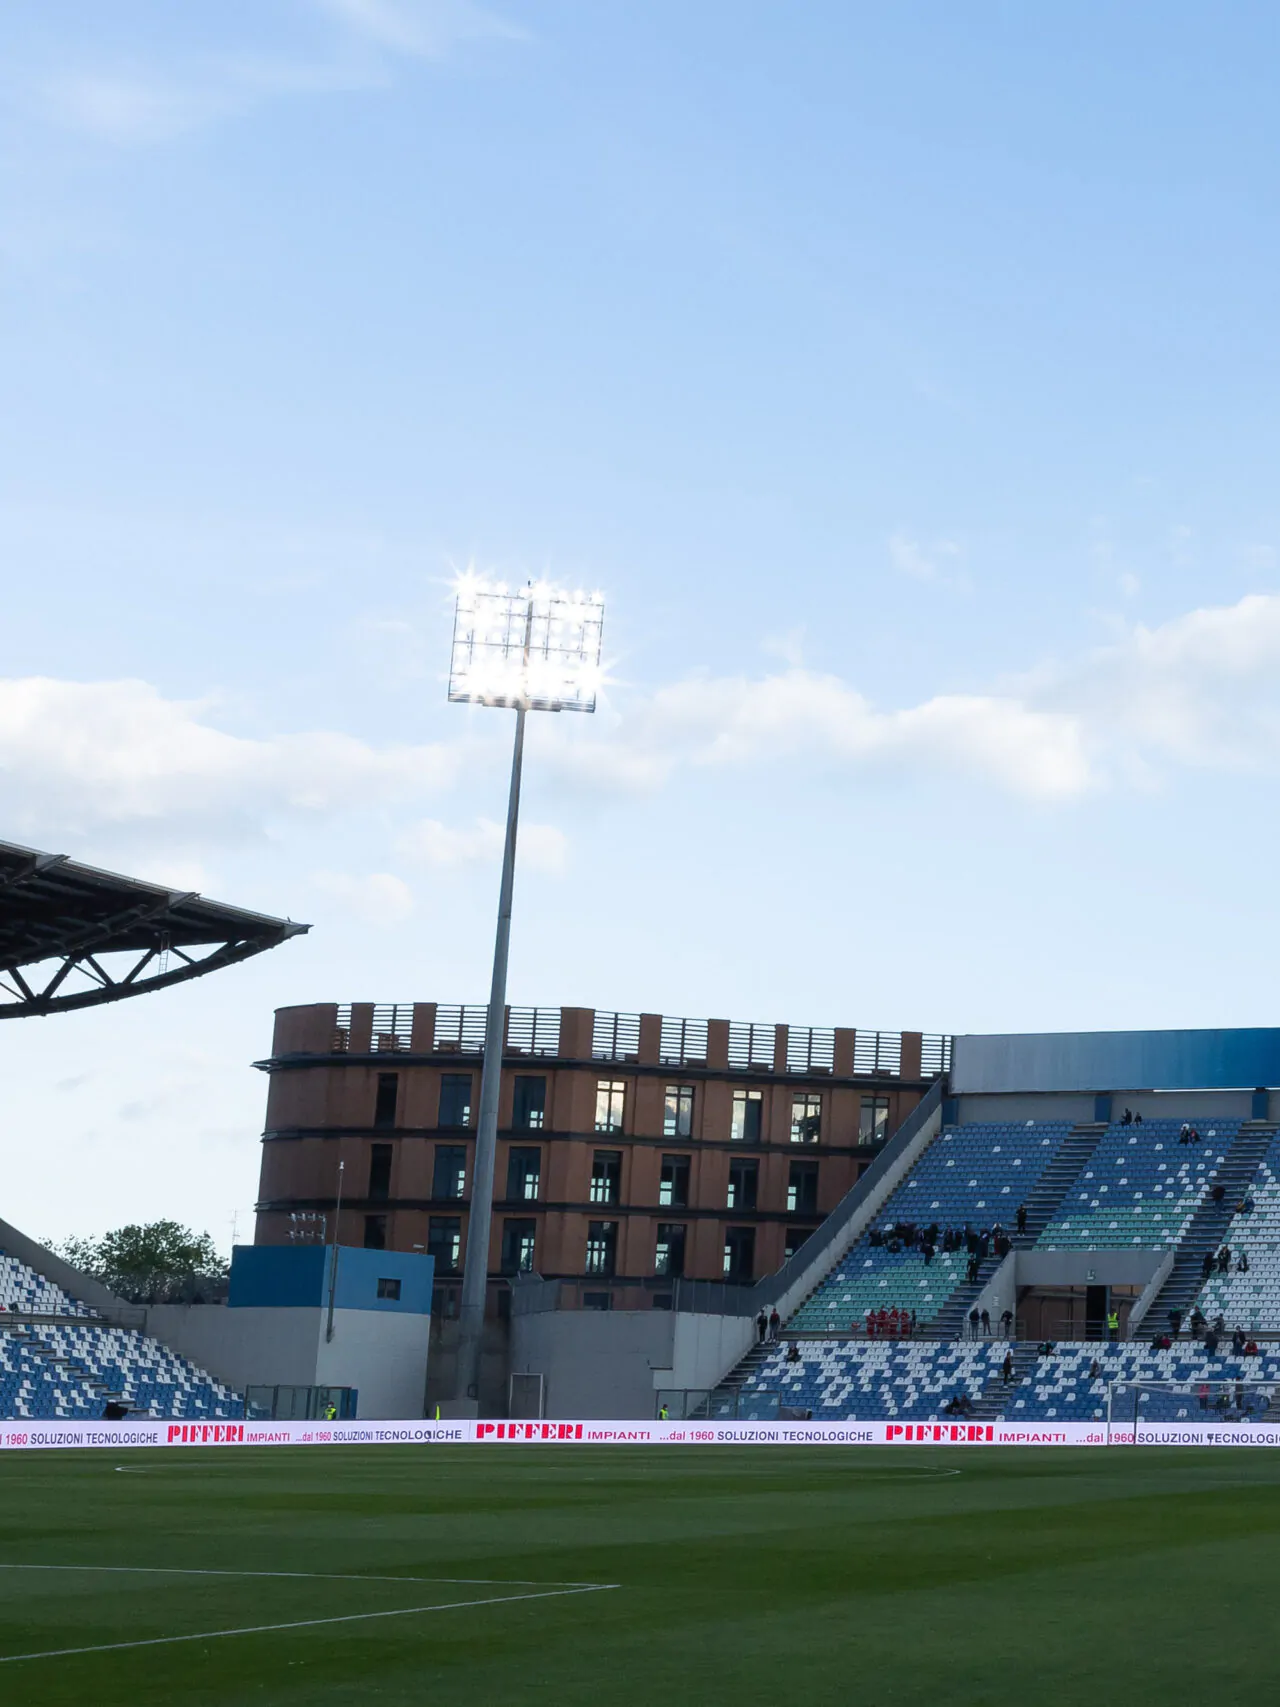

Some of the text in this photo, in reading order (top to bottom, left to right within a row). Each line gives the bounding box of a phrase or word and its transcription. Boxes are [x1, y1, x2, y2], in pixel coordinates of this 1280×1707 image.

[6, 1433, 28, 1445] 1960
[30, 1433, 84, 1445] SOLUZIONI
[85, 1432, 158, 1444] TECNOLOGICHE
[167, 1425, 244, 1443] PIFFERI
[247, 1432, 291, 1442] IMPIANTI
[316, 1431, 332, 1442] 1960
[333, 1431, 374, 1441] SOLUZIONI
[476, 1424, 583, 1439] PIFFERI
[587, 1431, 651, 1440] IMPIANTI
[690, 1430, 714, 1441] 1960
[717, 1431, 779, 1441] SOLUZIONI
[782, 1431, 873, 1441] TECNOLOGICHE
[886, 1425, 993, 1441] PIFFERI
[999, 1433, 1066, 1442] IMPIANTI
[1109, 1432, 1135, 1443] 1960
[1138, 1432, 1203, 1443] SOLUZIONI
